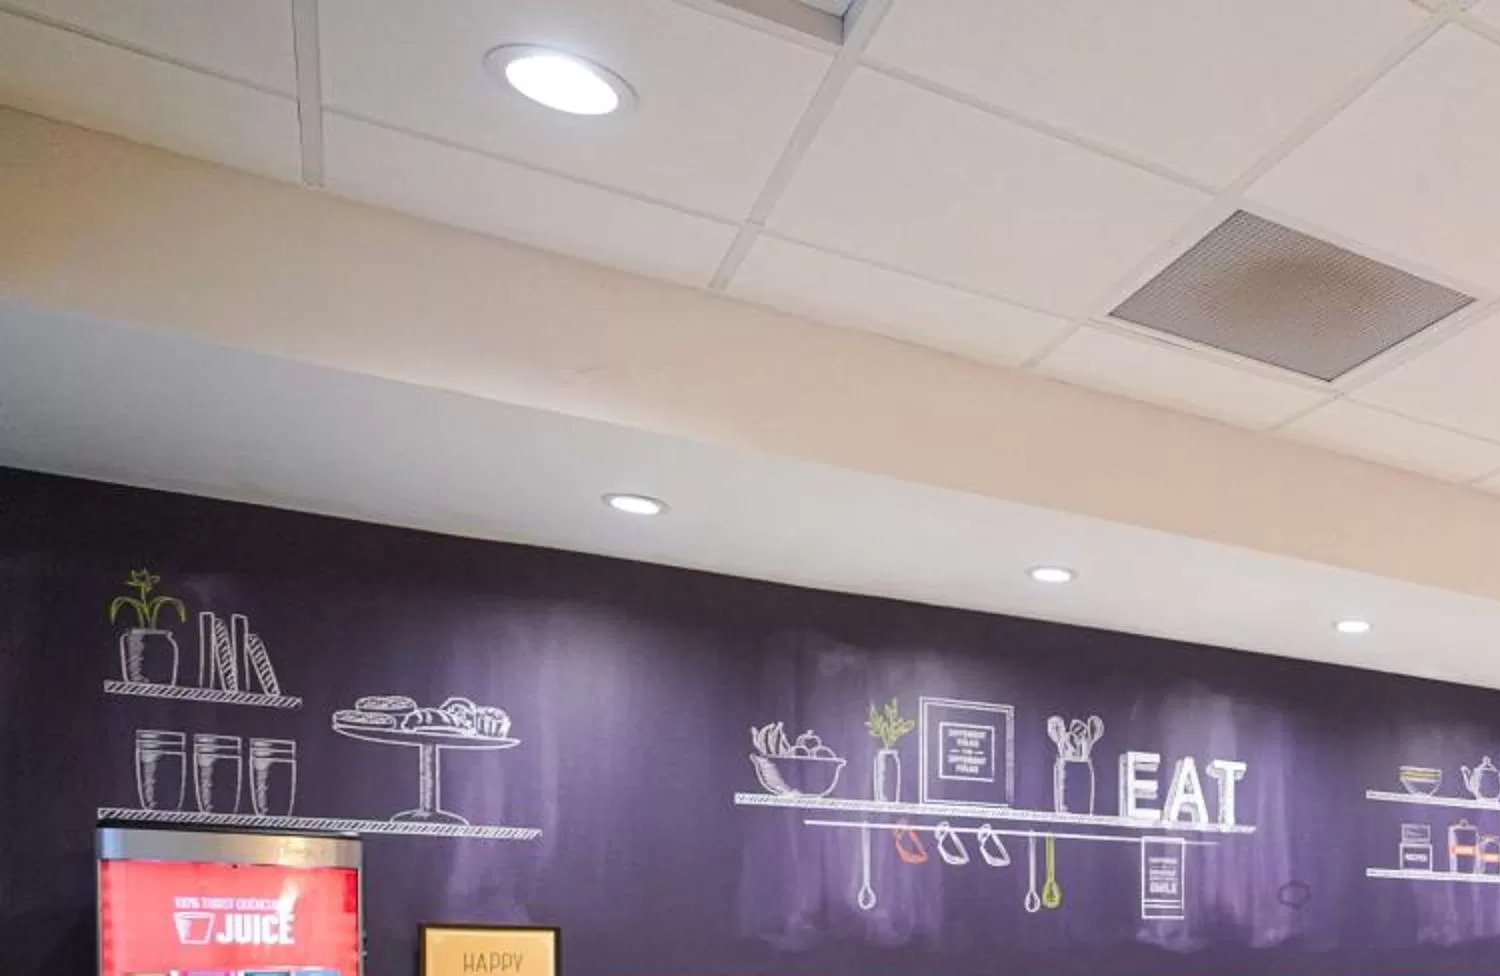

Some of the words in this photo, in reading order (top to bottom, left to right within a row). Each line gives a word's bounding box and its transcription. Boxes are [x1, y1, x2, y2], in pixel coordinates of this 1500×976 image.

[1118, 751, 1247, 829] EAT
[216, 912, 296, 945] JUICE
[463, 952, 523, 973] HAPPY
